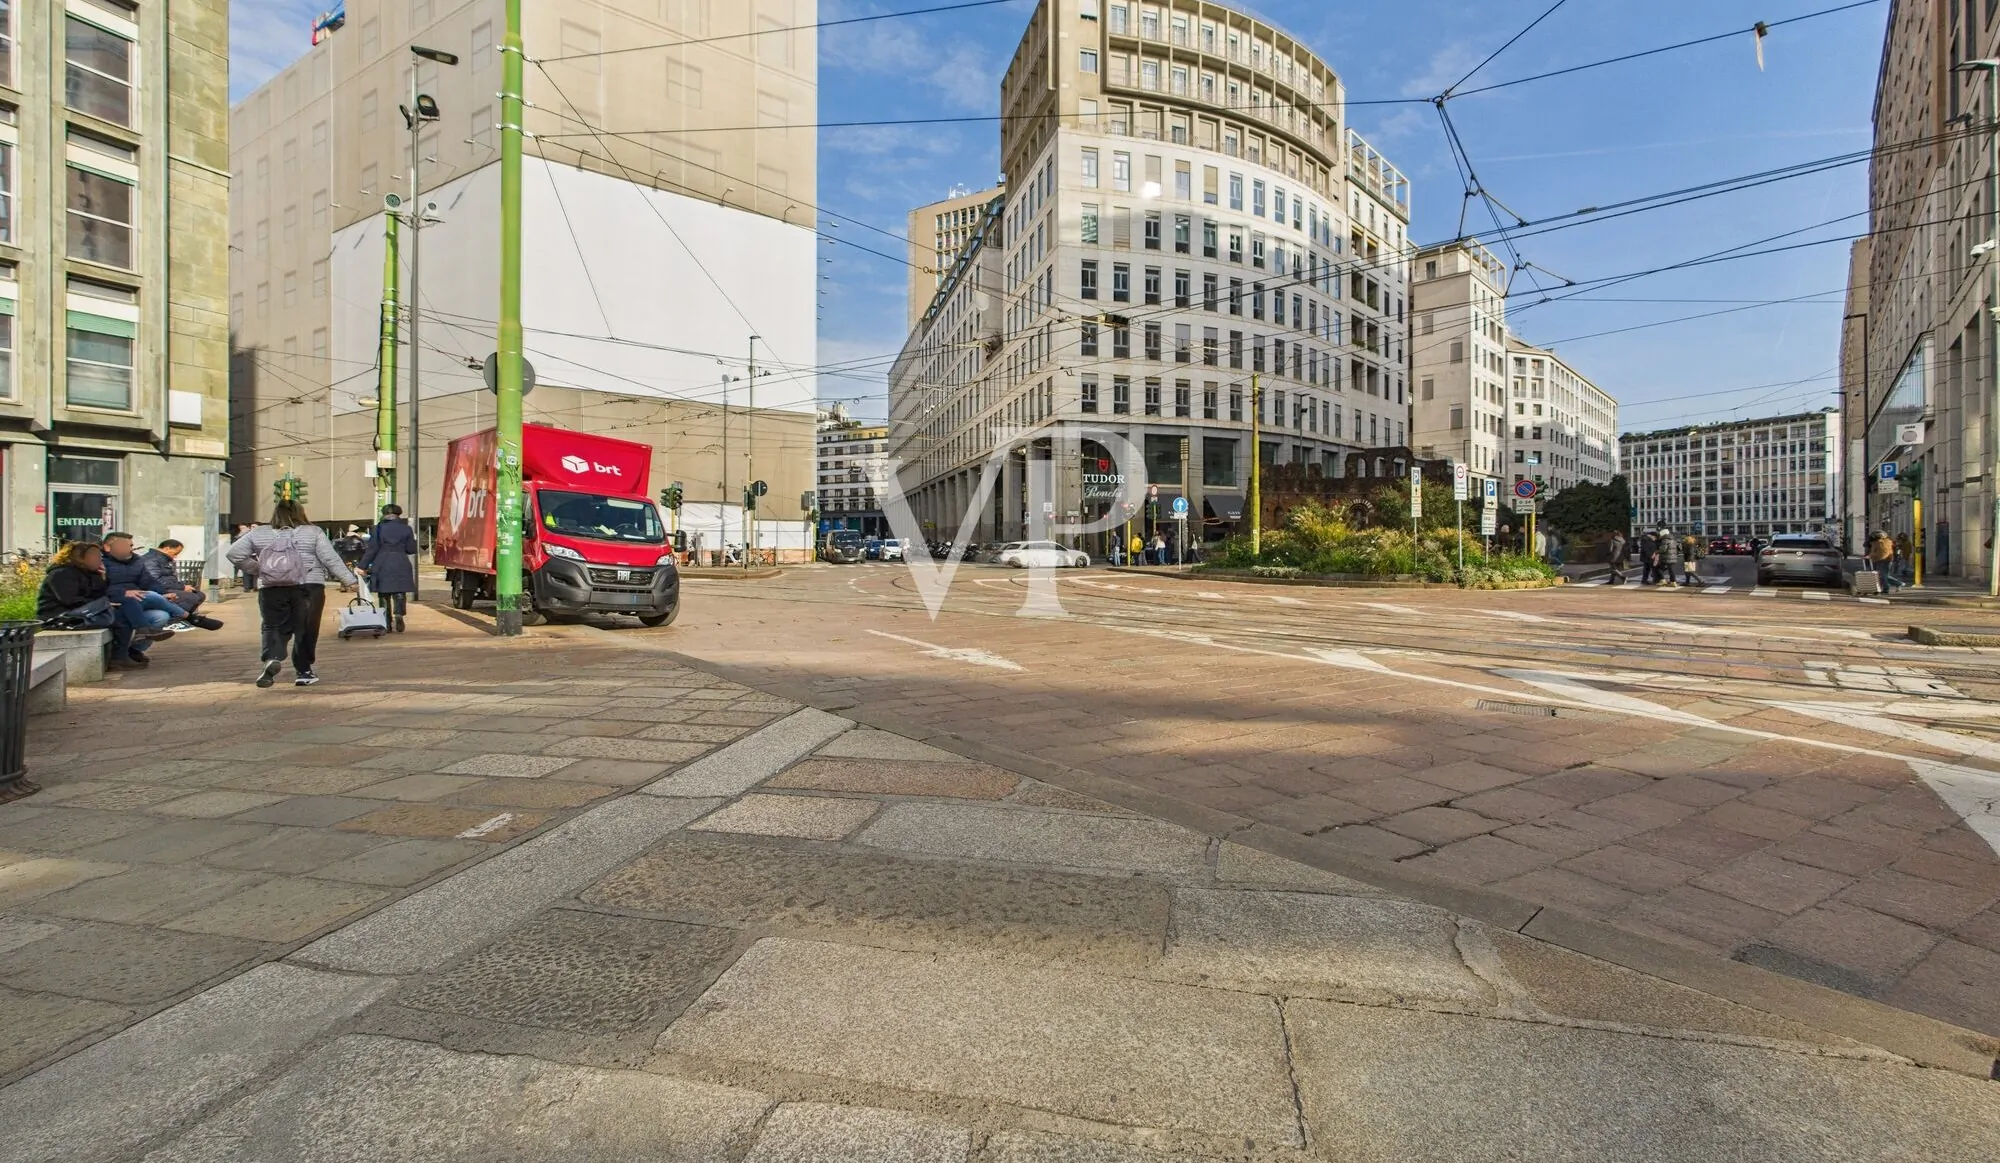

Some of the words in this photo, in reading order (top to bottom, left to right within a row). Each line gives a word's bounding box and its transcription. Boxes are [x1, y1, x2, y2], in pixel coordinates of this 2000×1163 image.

[593, 461, 622, 477] brt
[1884, 465, 1893, 477] P
[1083, 474, 1125, 484] TUDOR
[1487, 483, 1494, 496] P
[467, 479, 487, 518] brt
[57, 517, 104, 526] ENTRATA
